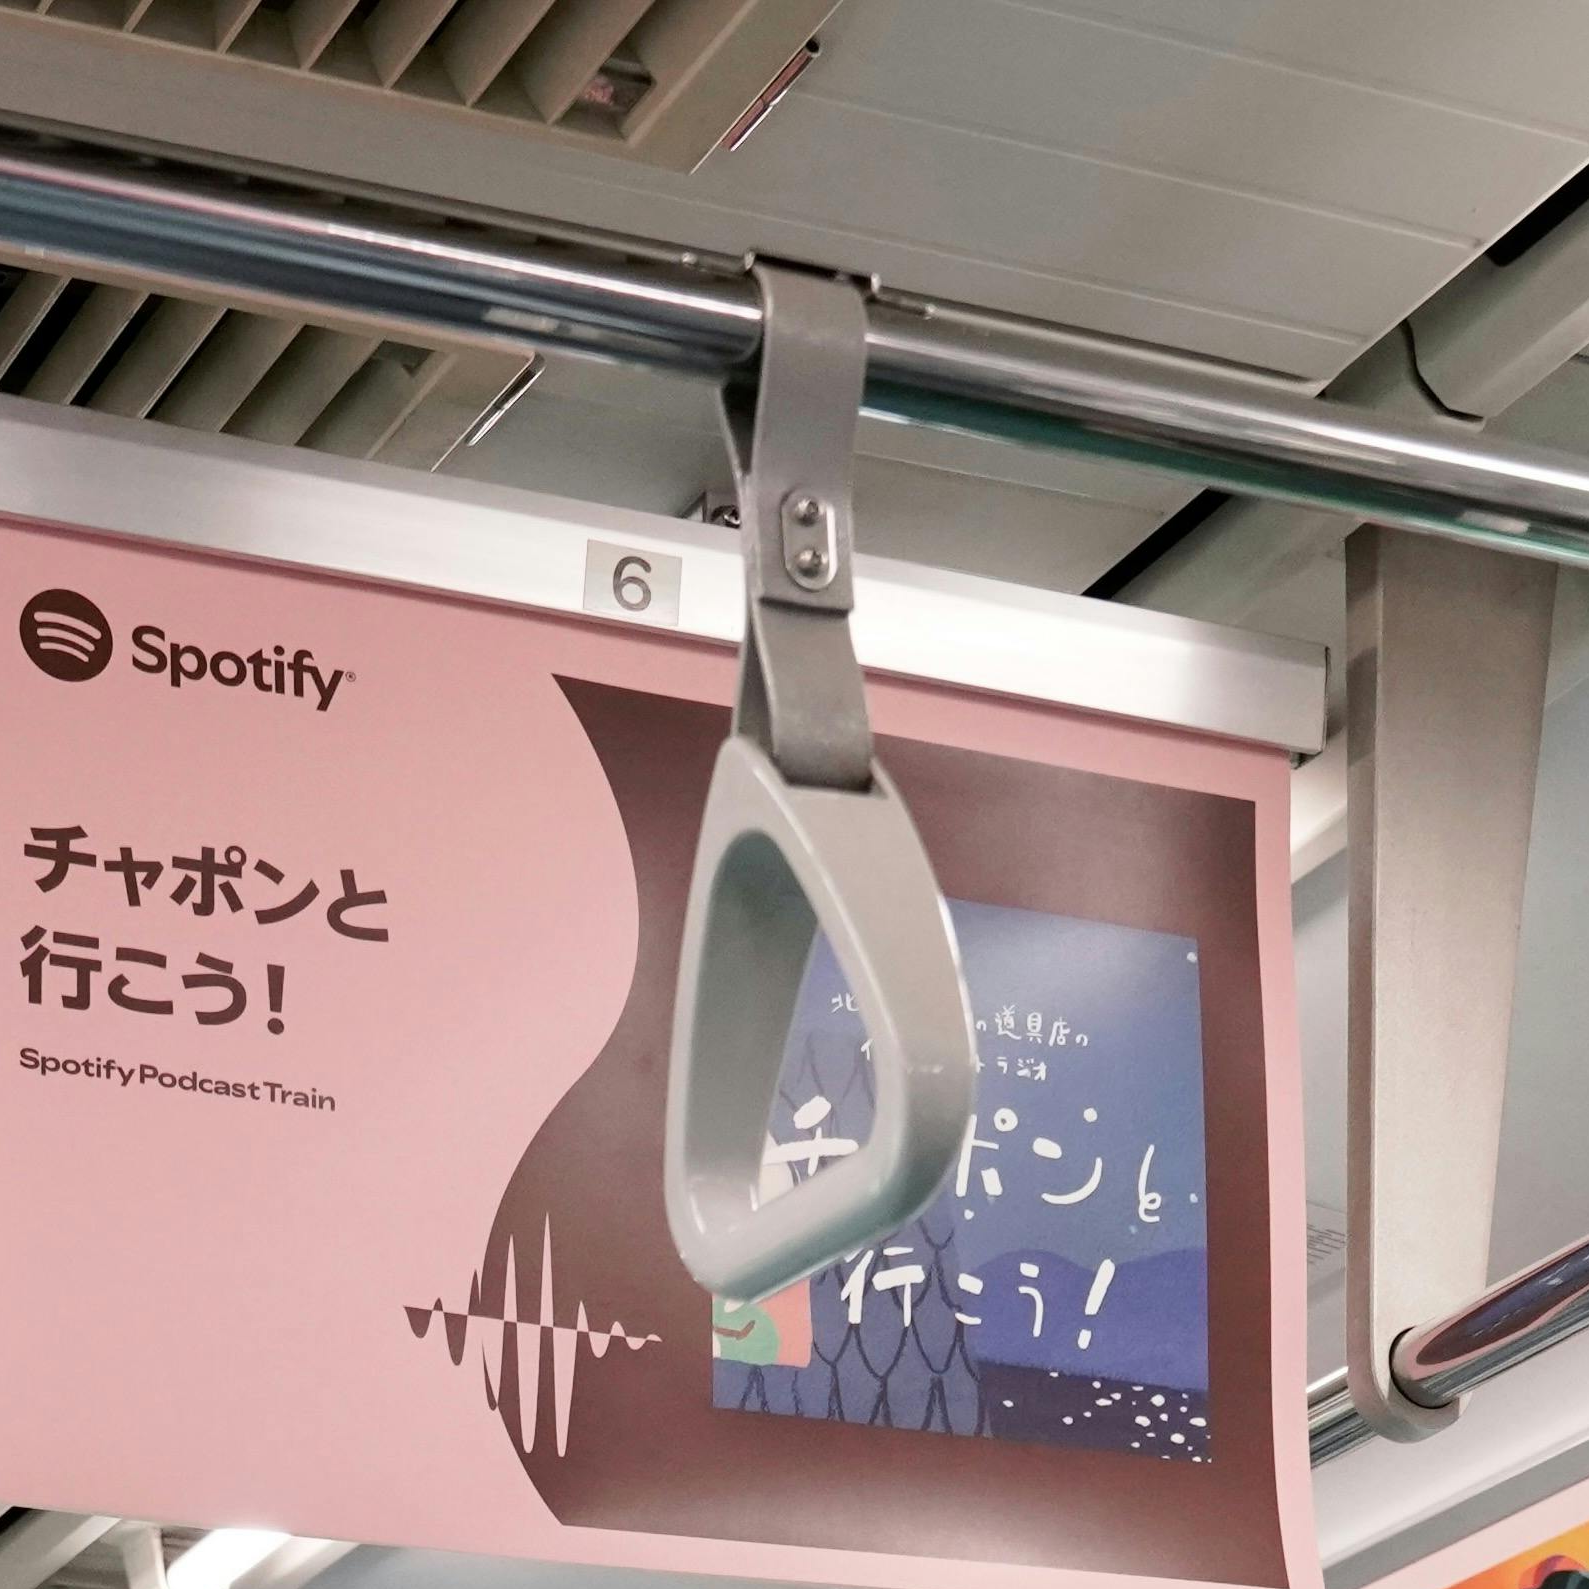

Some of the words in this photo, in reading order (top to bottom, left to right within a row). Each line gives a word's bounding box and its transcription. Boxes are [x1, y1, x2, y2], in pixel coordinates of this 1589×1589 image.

[612, 554, 653, 613] 6
[23, 825, 391, 943] チャポンと
[19, 926, 287, 1035] 行こう!
[137, 1067, 261, 1103] Podcast
[262, 1081, 337, 1112] Train
